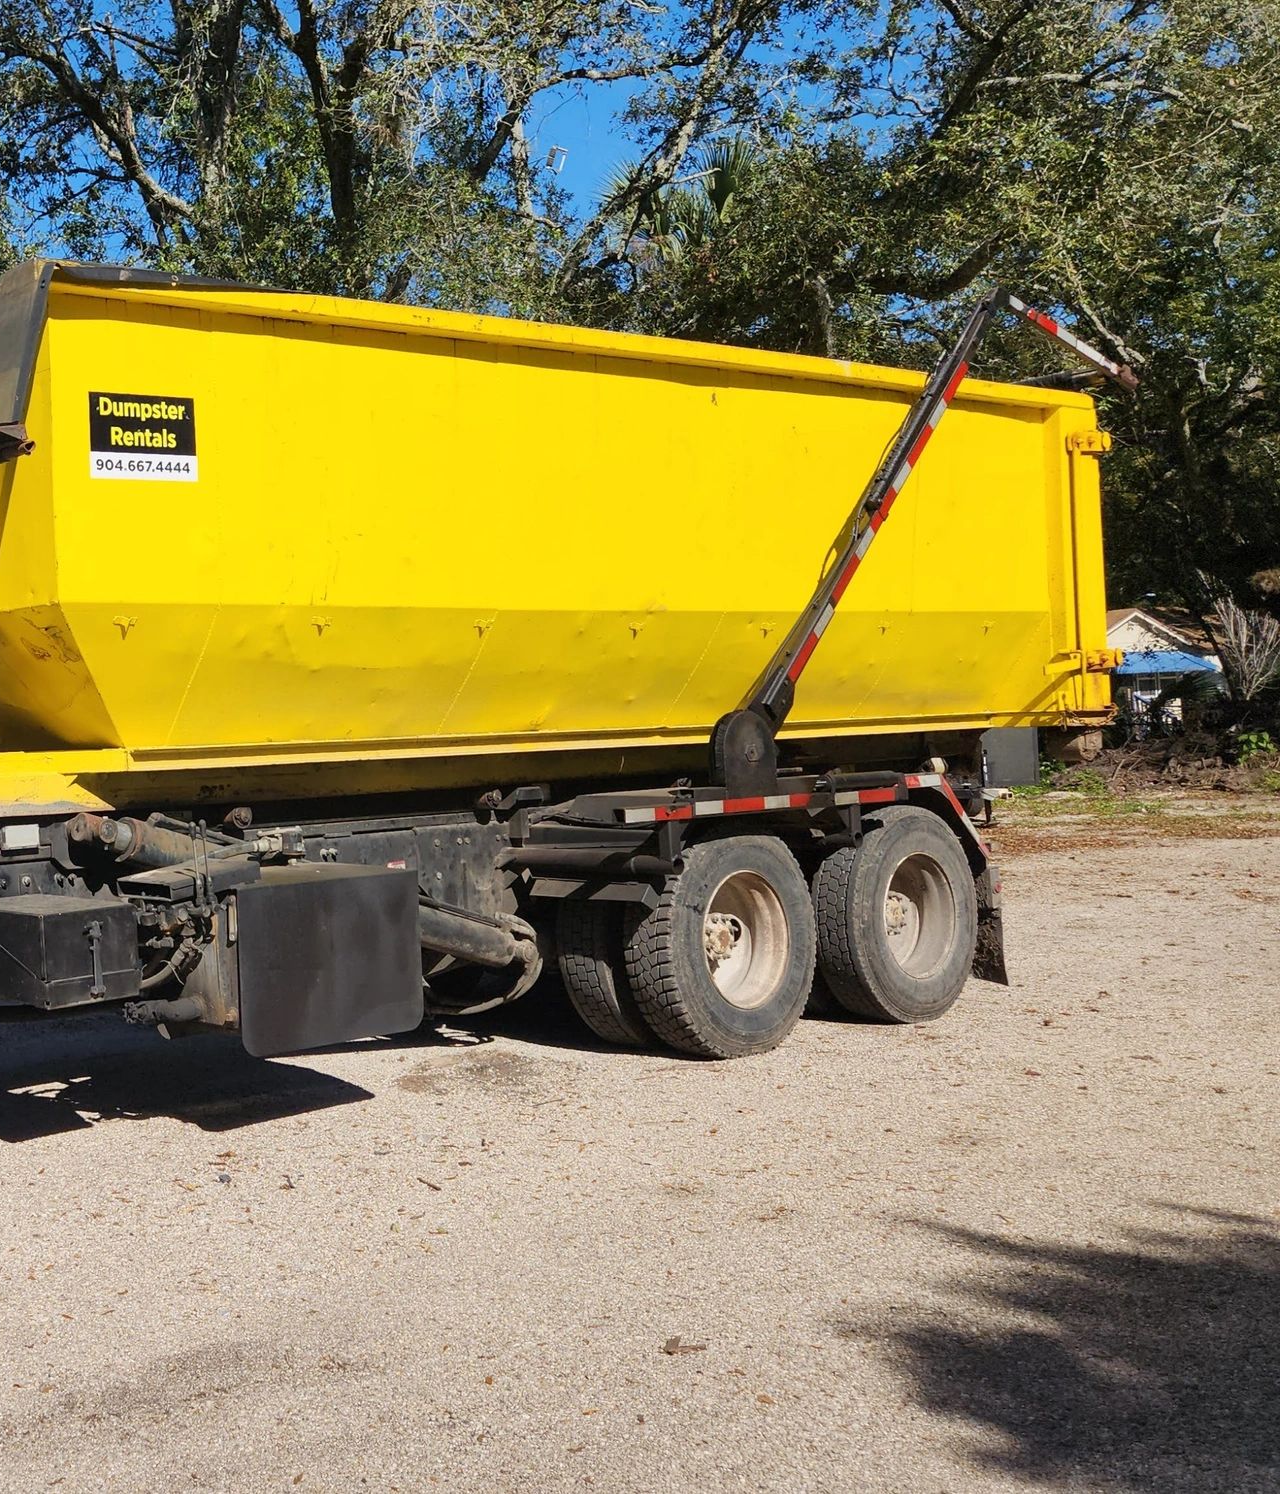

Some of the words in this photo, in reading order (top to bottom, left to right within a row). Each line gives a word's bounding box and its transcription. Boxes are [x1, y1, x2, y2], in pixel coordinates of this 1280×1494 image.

[99, 396, 185, 421] Dumpster
[110, 426, 177, 448] Rentals
[96, 459, 190, 473] 904.667.4444
